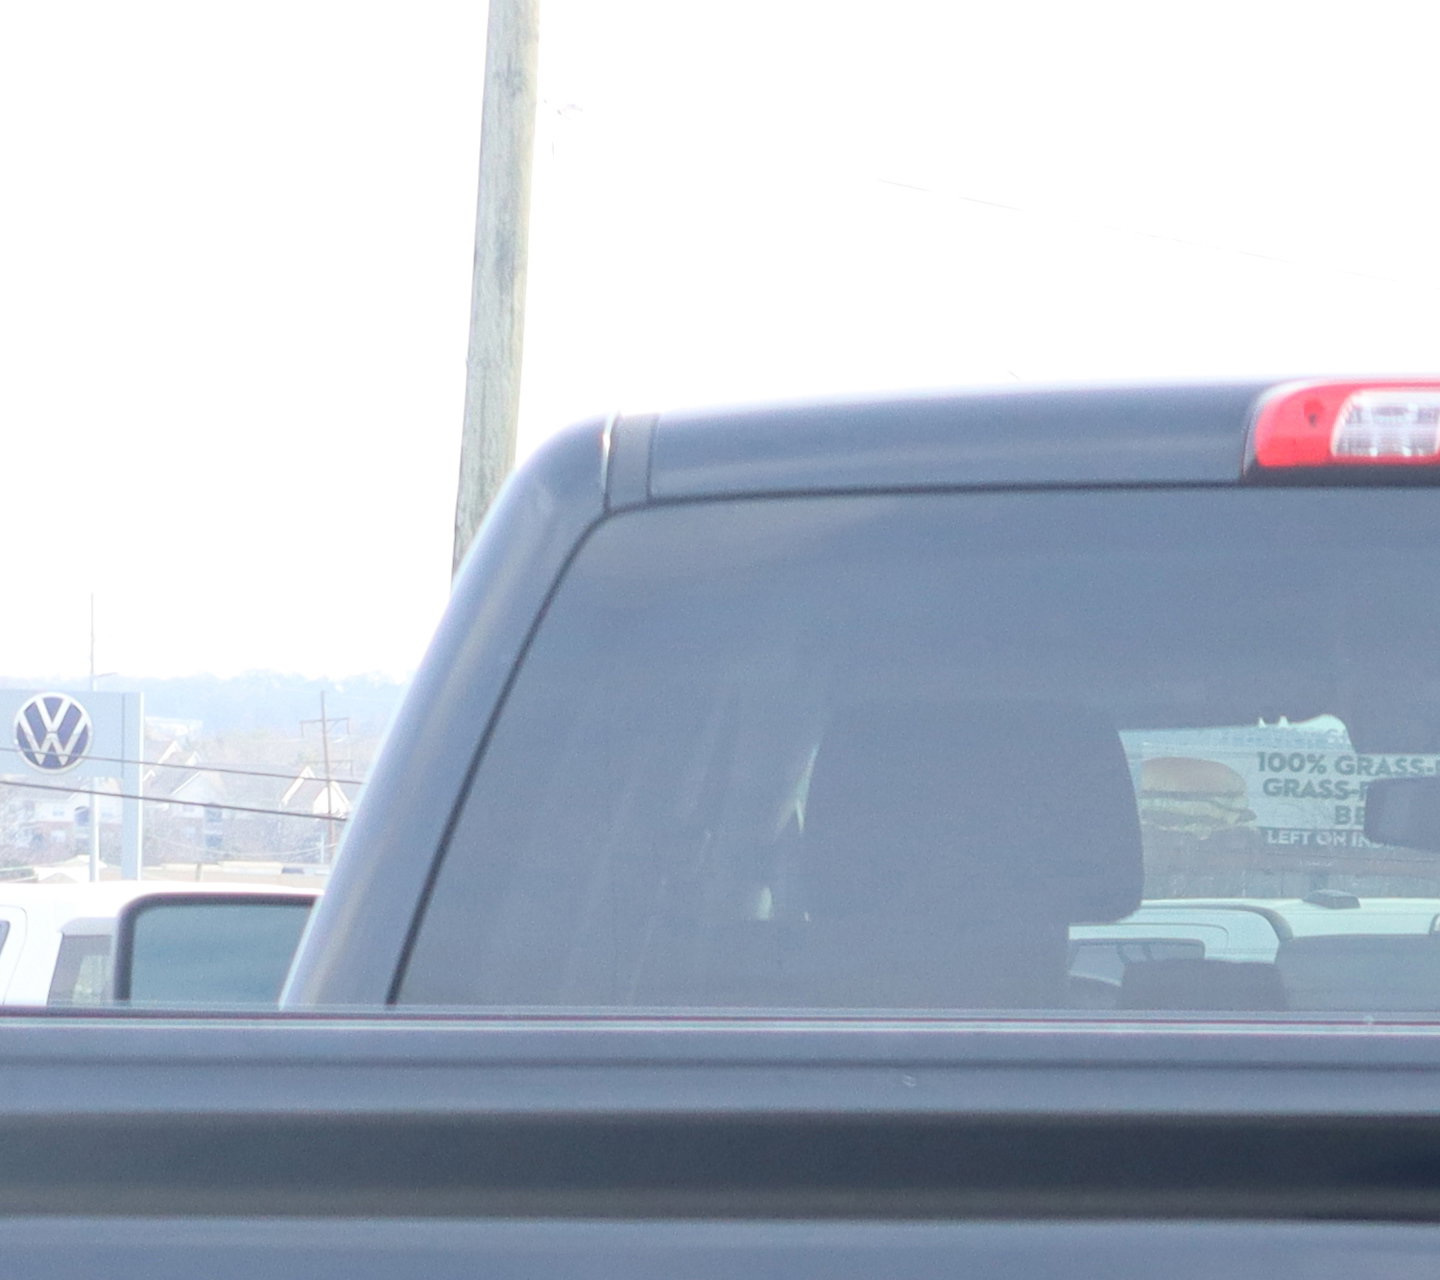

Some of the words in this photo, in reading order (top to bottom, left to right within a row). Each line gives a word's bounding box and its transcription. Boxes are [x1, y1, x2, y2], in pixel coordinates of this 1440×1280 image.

[1258, 751, 1327, 774] 100%
[1262, 777, 1368, 800] GRASS-F
[1266, 830, 1310, 845] LEFT
